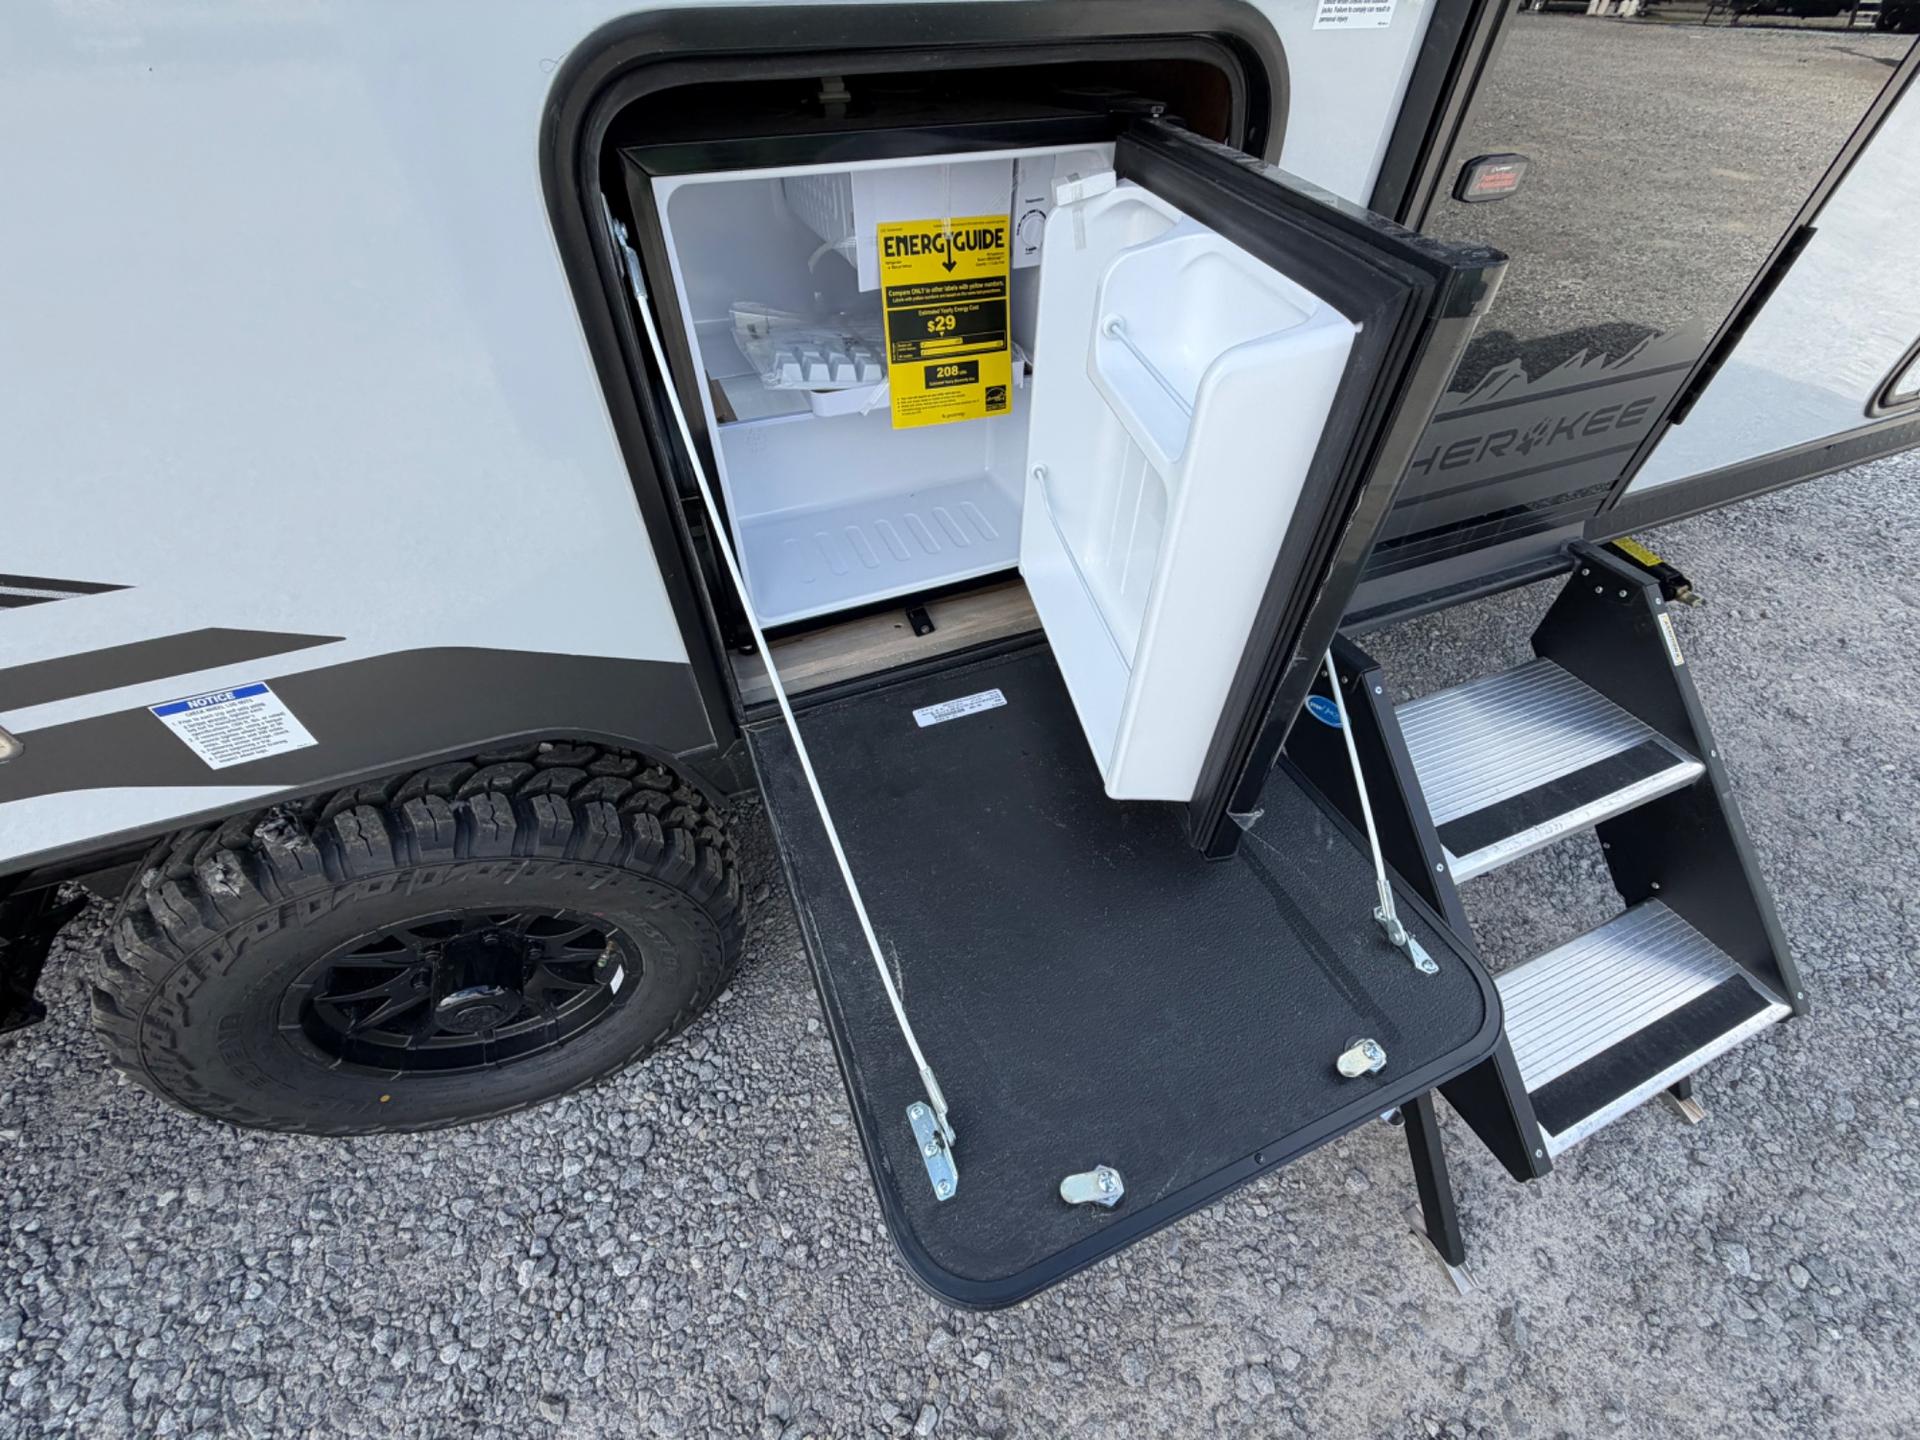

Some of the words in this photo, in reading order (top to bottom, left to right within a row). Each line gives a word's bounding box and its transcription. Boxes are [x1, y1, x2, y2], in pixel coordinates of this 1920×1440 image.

[884, 228, 1005, 257] ENERGYGUIDE
[927, 315, 956, 333] $29
[937, 365, 959, 378] 208
[1412, 396, 1657, 475] HEROKEE
[187, 691, 236, 710] NOTICE
